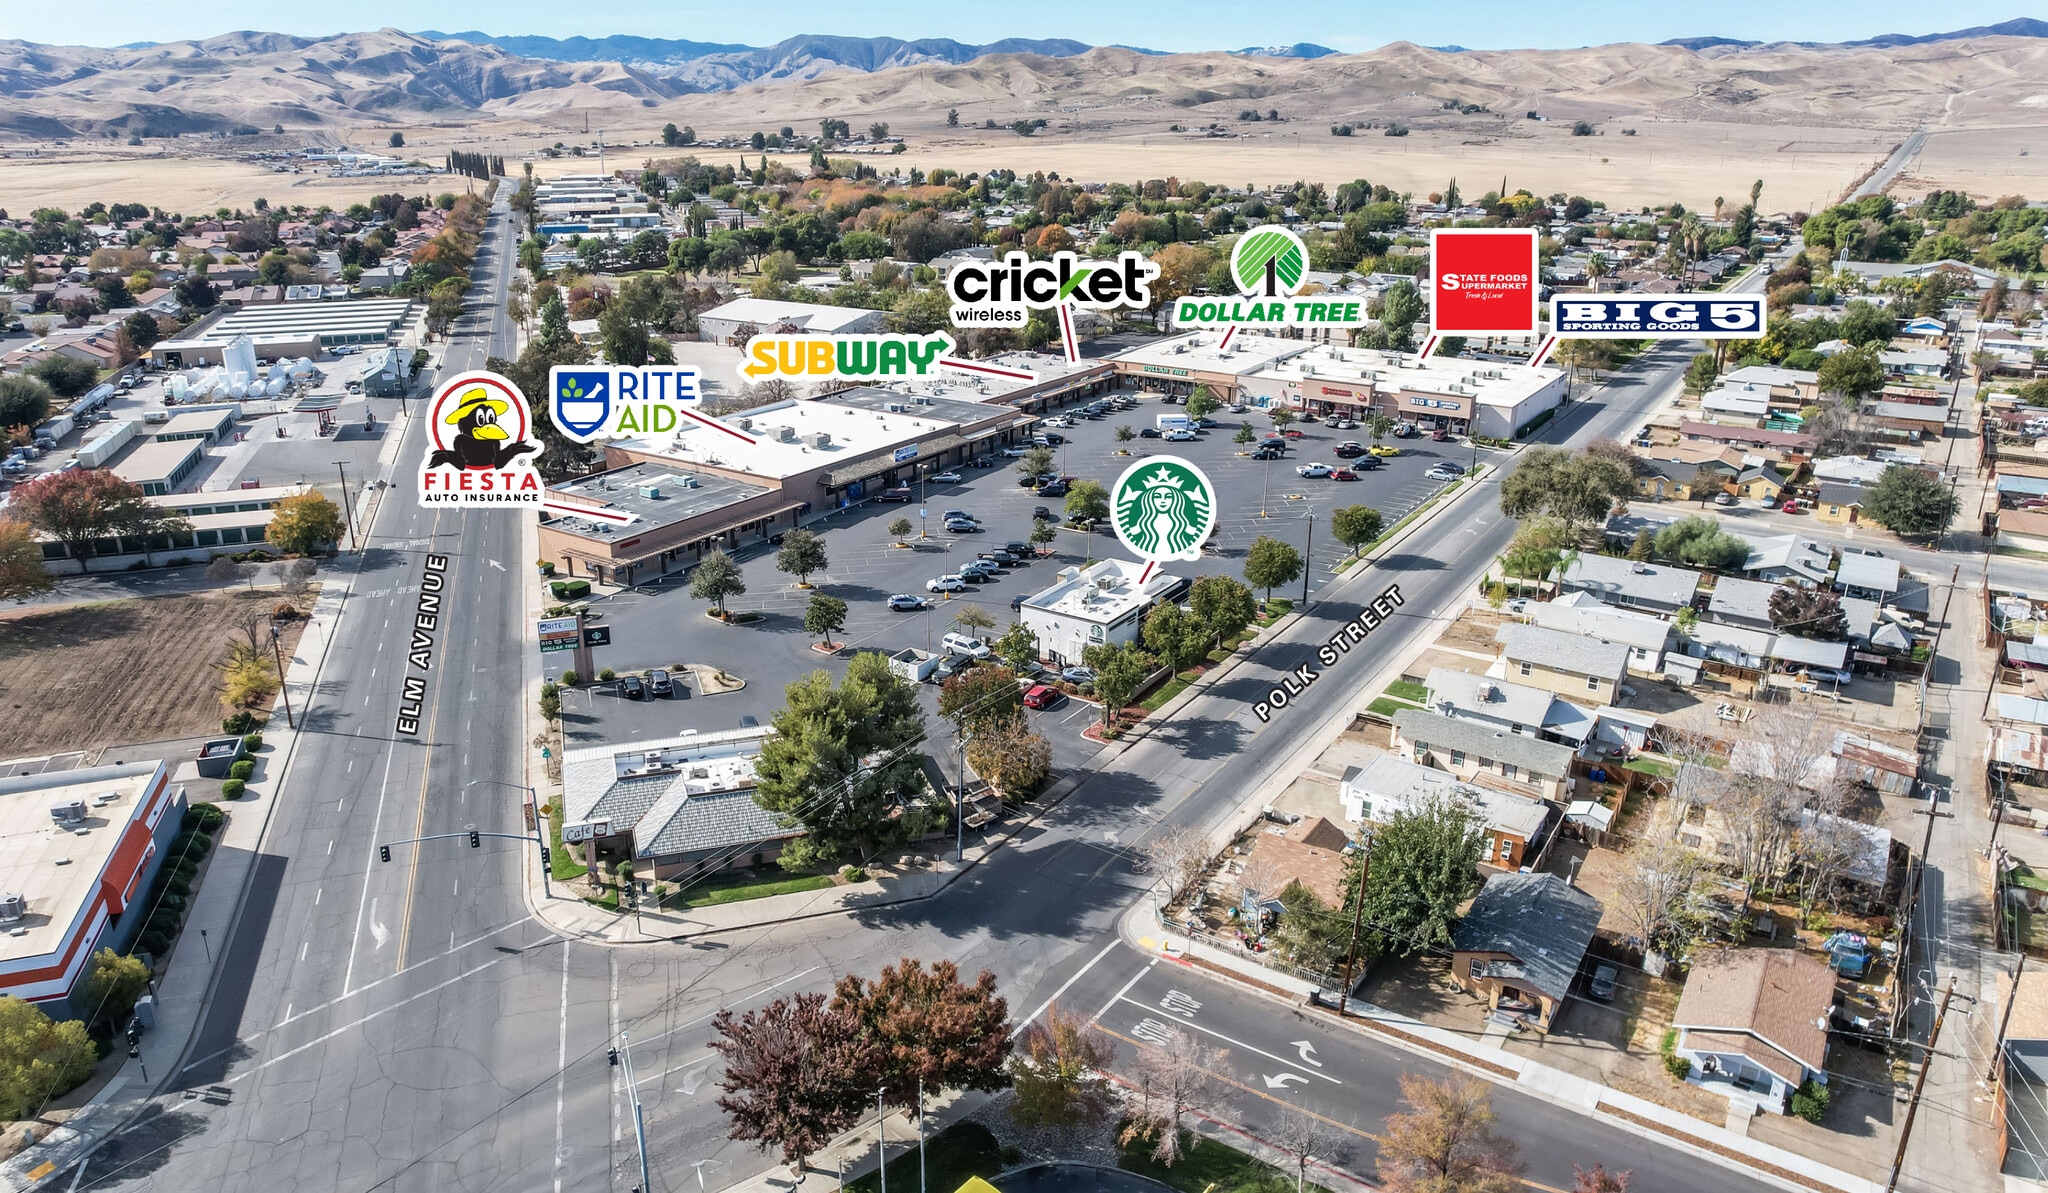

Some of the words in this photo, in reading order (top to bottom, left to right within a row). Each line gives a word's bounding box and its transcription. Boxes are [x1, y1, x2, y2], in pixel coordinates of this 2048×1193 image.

[1144, 366, 1169, 375] DOLLAR
[547, 622, 563, 630] RITE
[566, 825, 591, 841] Cafe
[1160, 989, 1202, 1017] STOP
[1131, 1018, 1175, 1046] STOP
